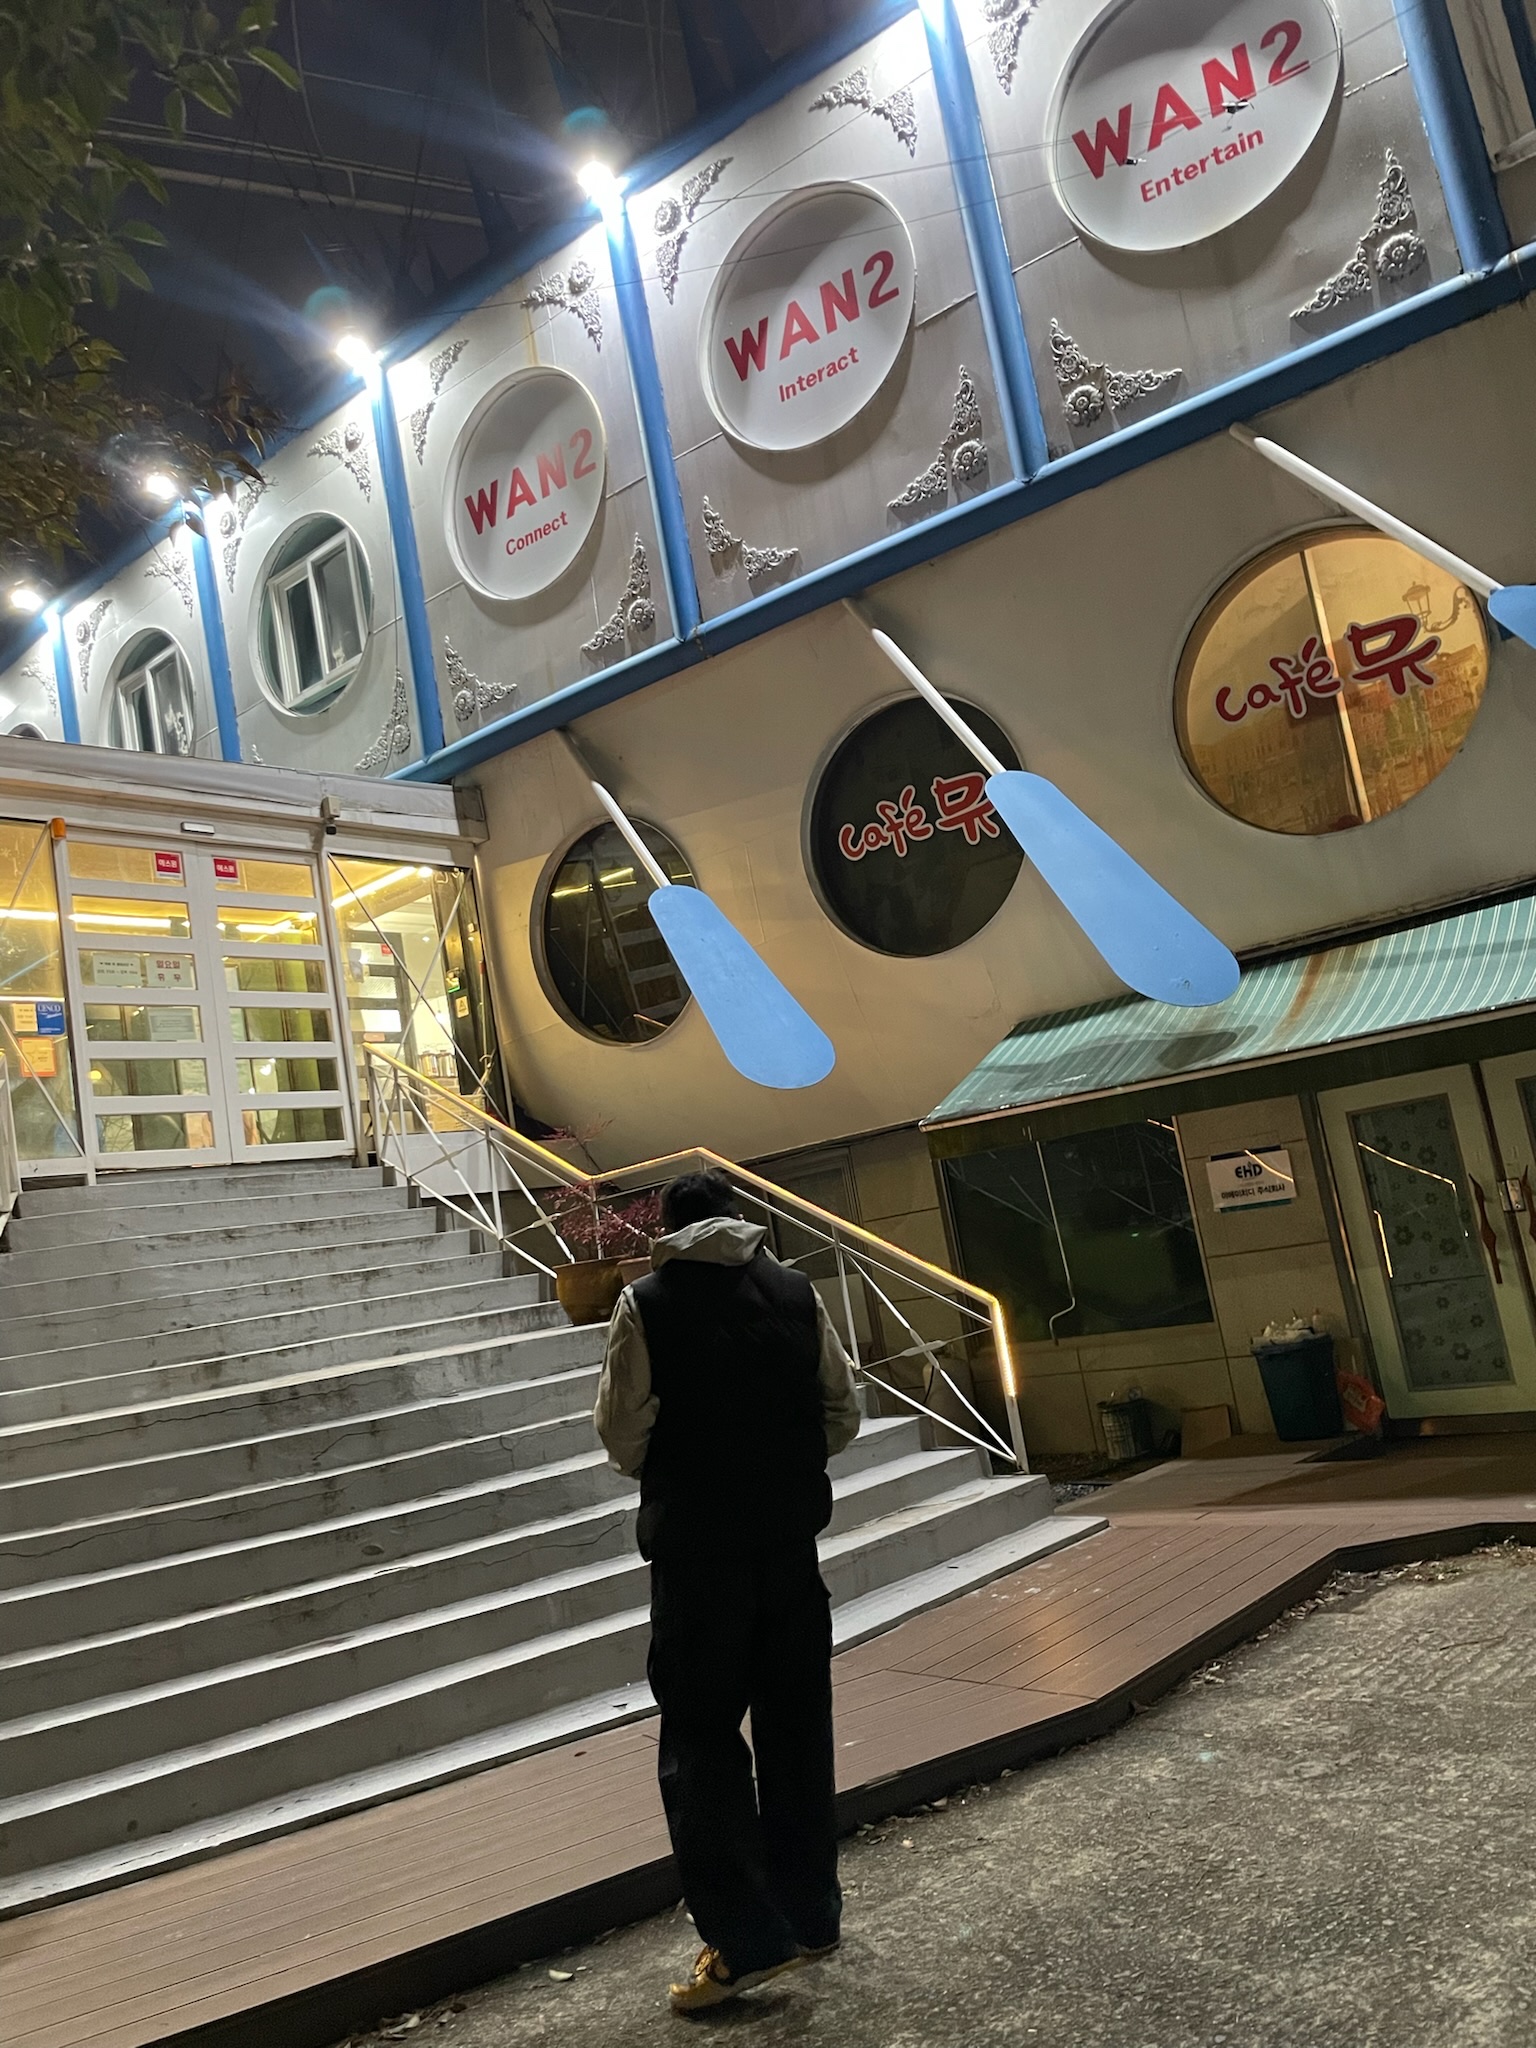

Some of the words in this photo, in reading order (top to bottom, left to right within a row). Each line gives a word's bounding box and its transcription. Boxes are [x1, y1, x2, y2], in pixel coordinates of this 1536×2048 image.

[1072, 20, 1310, 180] WAN2
[1140, 130, 1264, 203] Entertain
[723, 250, 899, 382] WAN2
[778, 346, 859, 402] Interact
[464, 428, 597, 535] WAN2
[505, 511, 568, 555] Connect
[156, 960, 181, 969] 일요일
[1234, 1162, 1263, 1178] EHD
[1257, 1183, 1286, 1195] 주식회사
